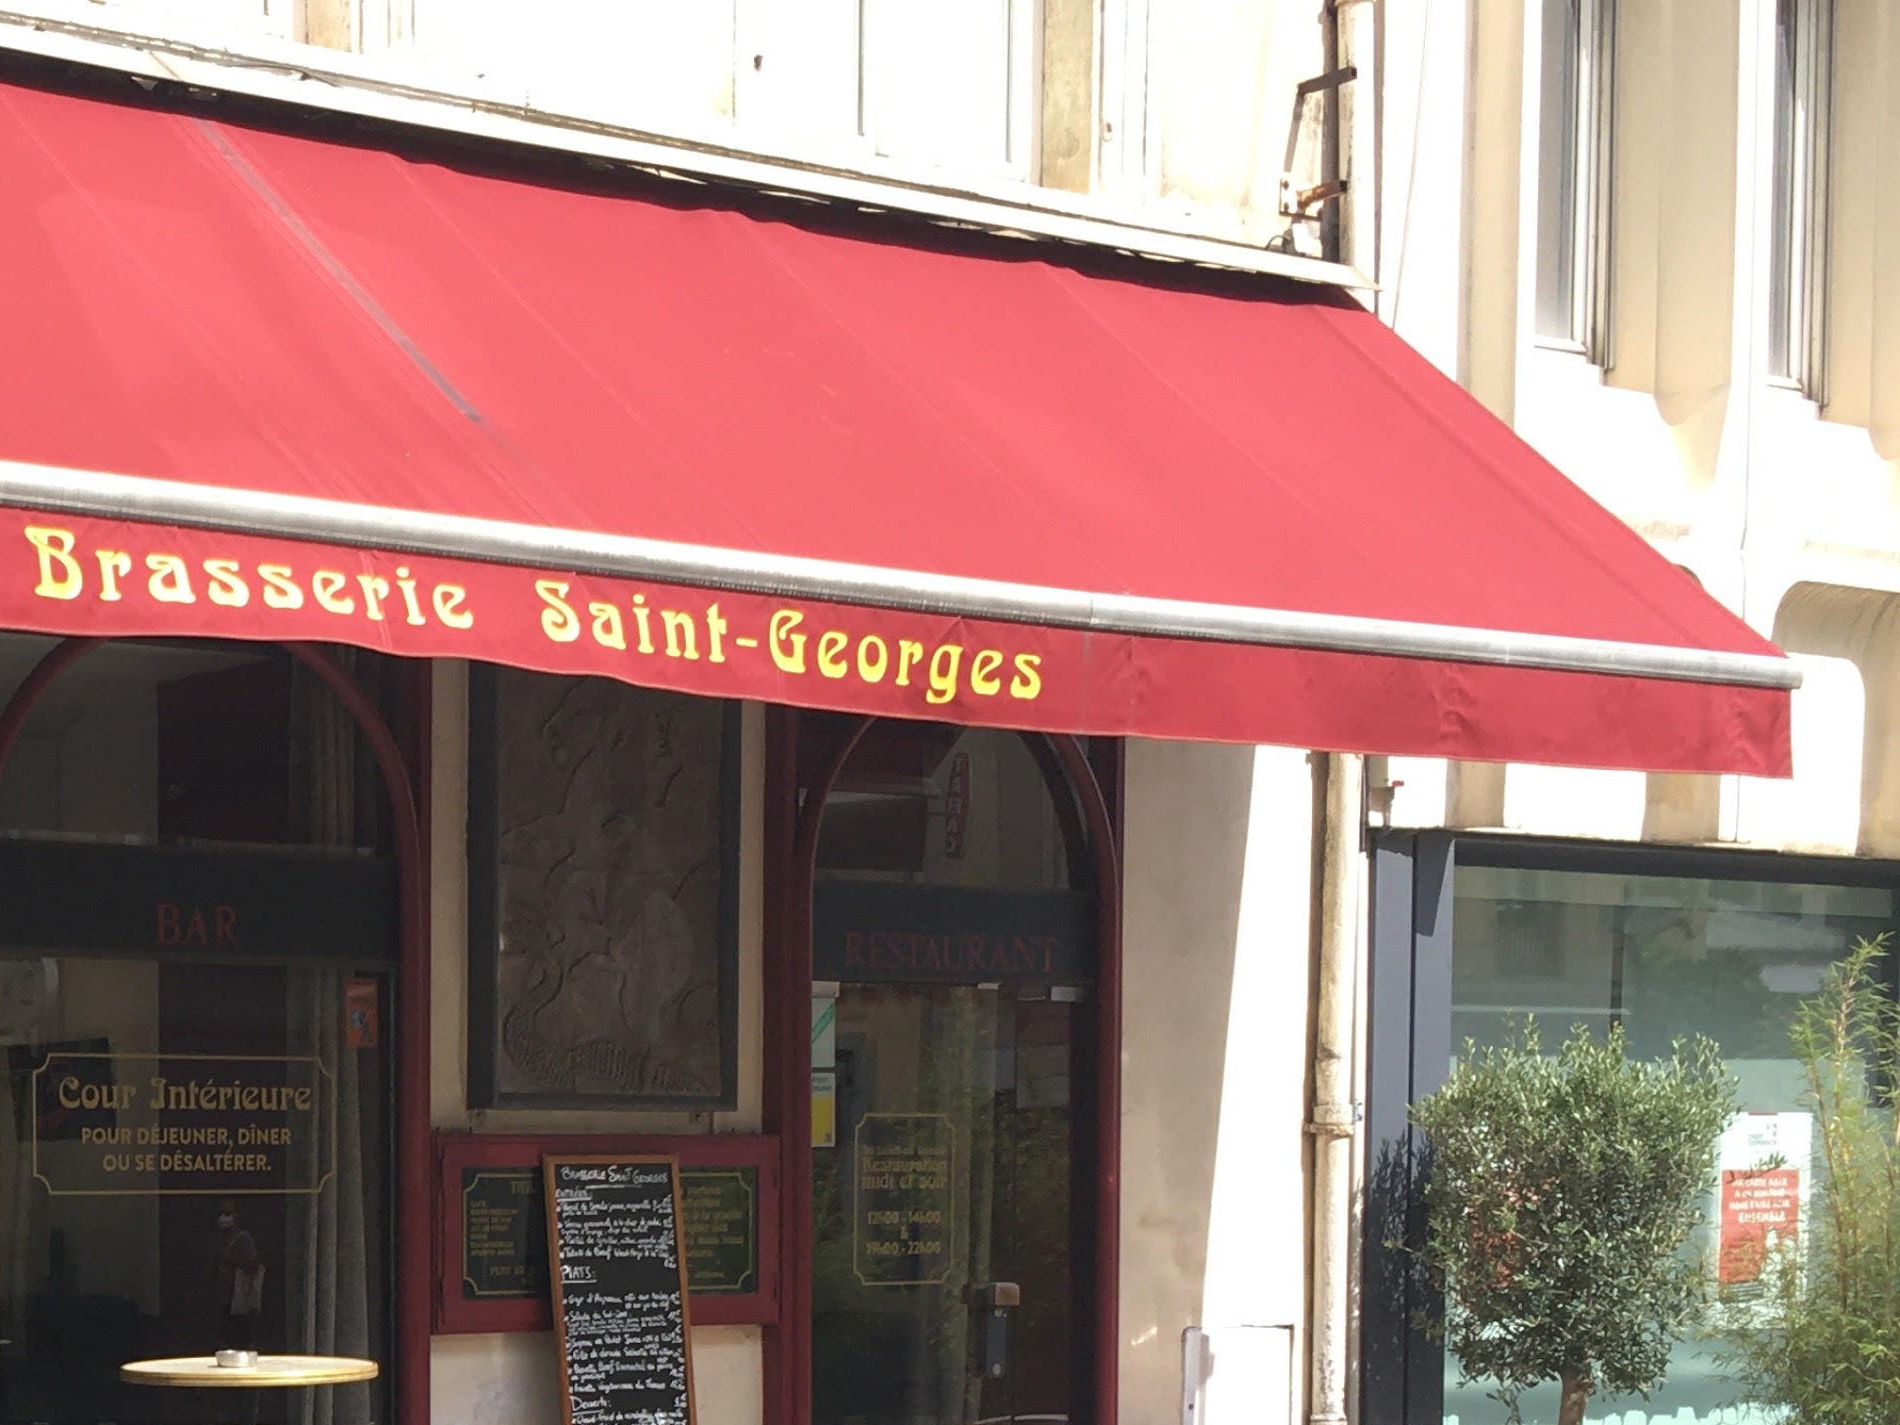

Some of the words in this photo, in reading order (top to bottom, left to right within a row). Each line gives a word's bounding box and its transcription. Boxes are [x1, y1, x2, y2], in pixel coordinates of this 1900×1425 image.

[24, 525, 475, 629] Brasserie
[535, 579, 1042, 705] Saint-Georges
[155, 899, 239, 950] BAR
[843, 929, 1060, 973] RESTAURANT
[58, 1076, 137, 1110] Cour
[149, 1077, 312, 1111] Intérieure
[81, 1127, 132, 1145] POUR
[137, 1124, 233, 1150] DÉJEUNER,
[238, 1124, 291, 1146] DÎNER
[103, 1154, 130, 1172] OU
[136, 1154, 155, 1172] SE
[160, 1150, 272, 1173] DÉSALTÉRER.
[862, 1157, 947, 1172] Restauration
[862, 1172, 894, 1189] midi
[899, 1174, 912, 1189] et
[919, 1175, 948, 1189] soir
[908, 1210, 940, 1224] 14h00
[907, 1241, 941, 1255] 22h00
